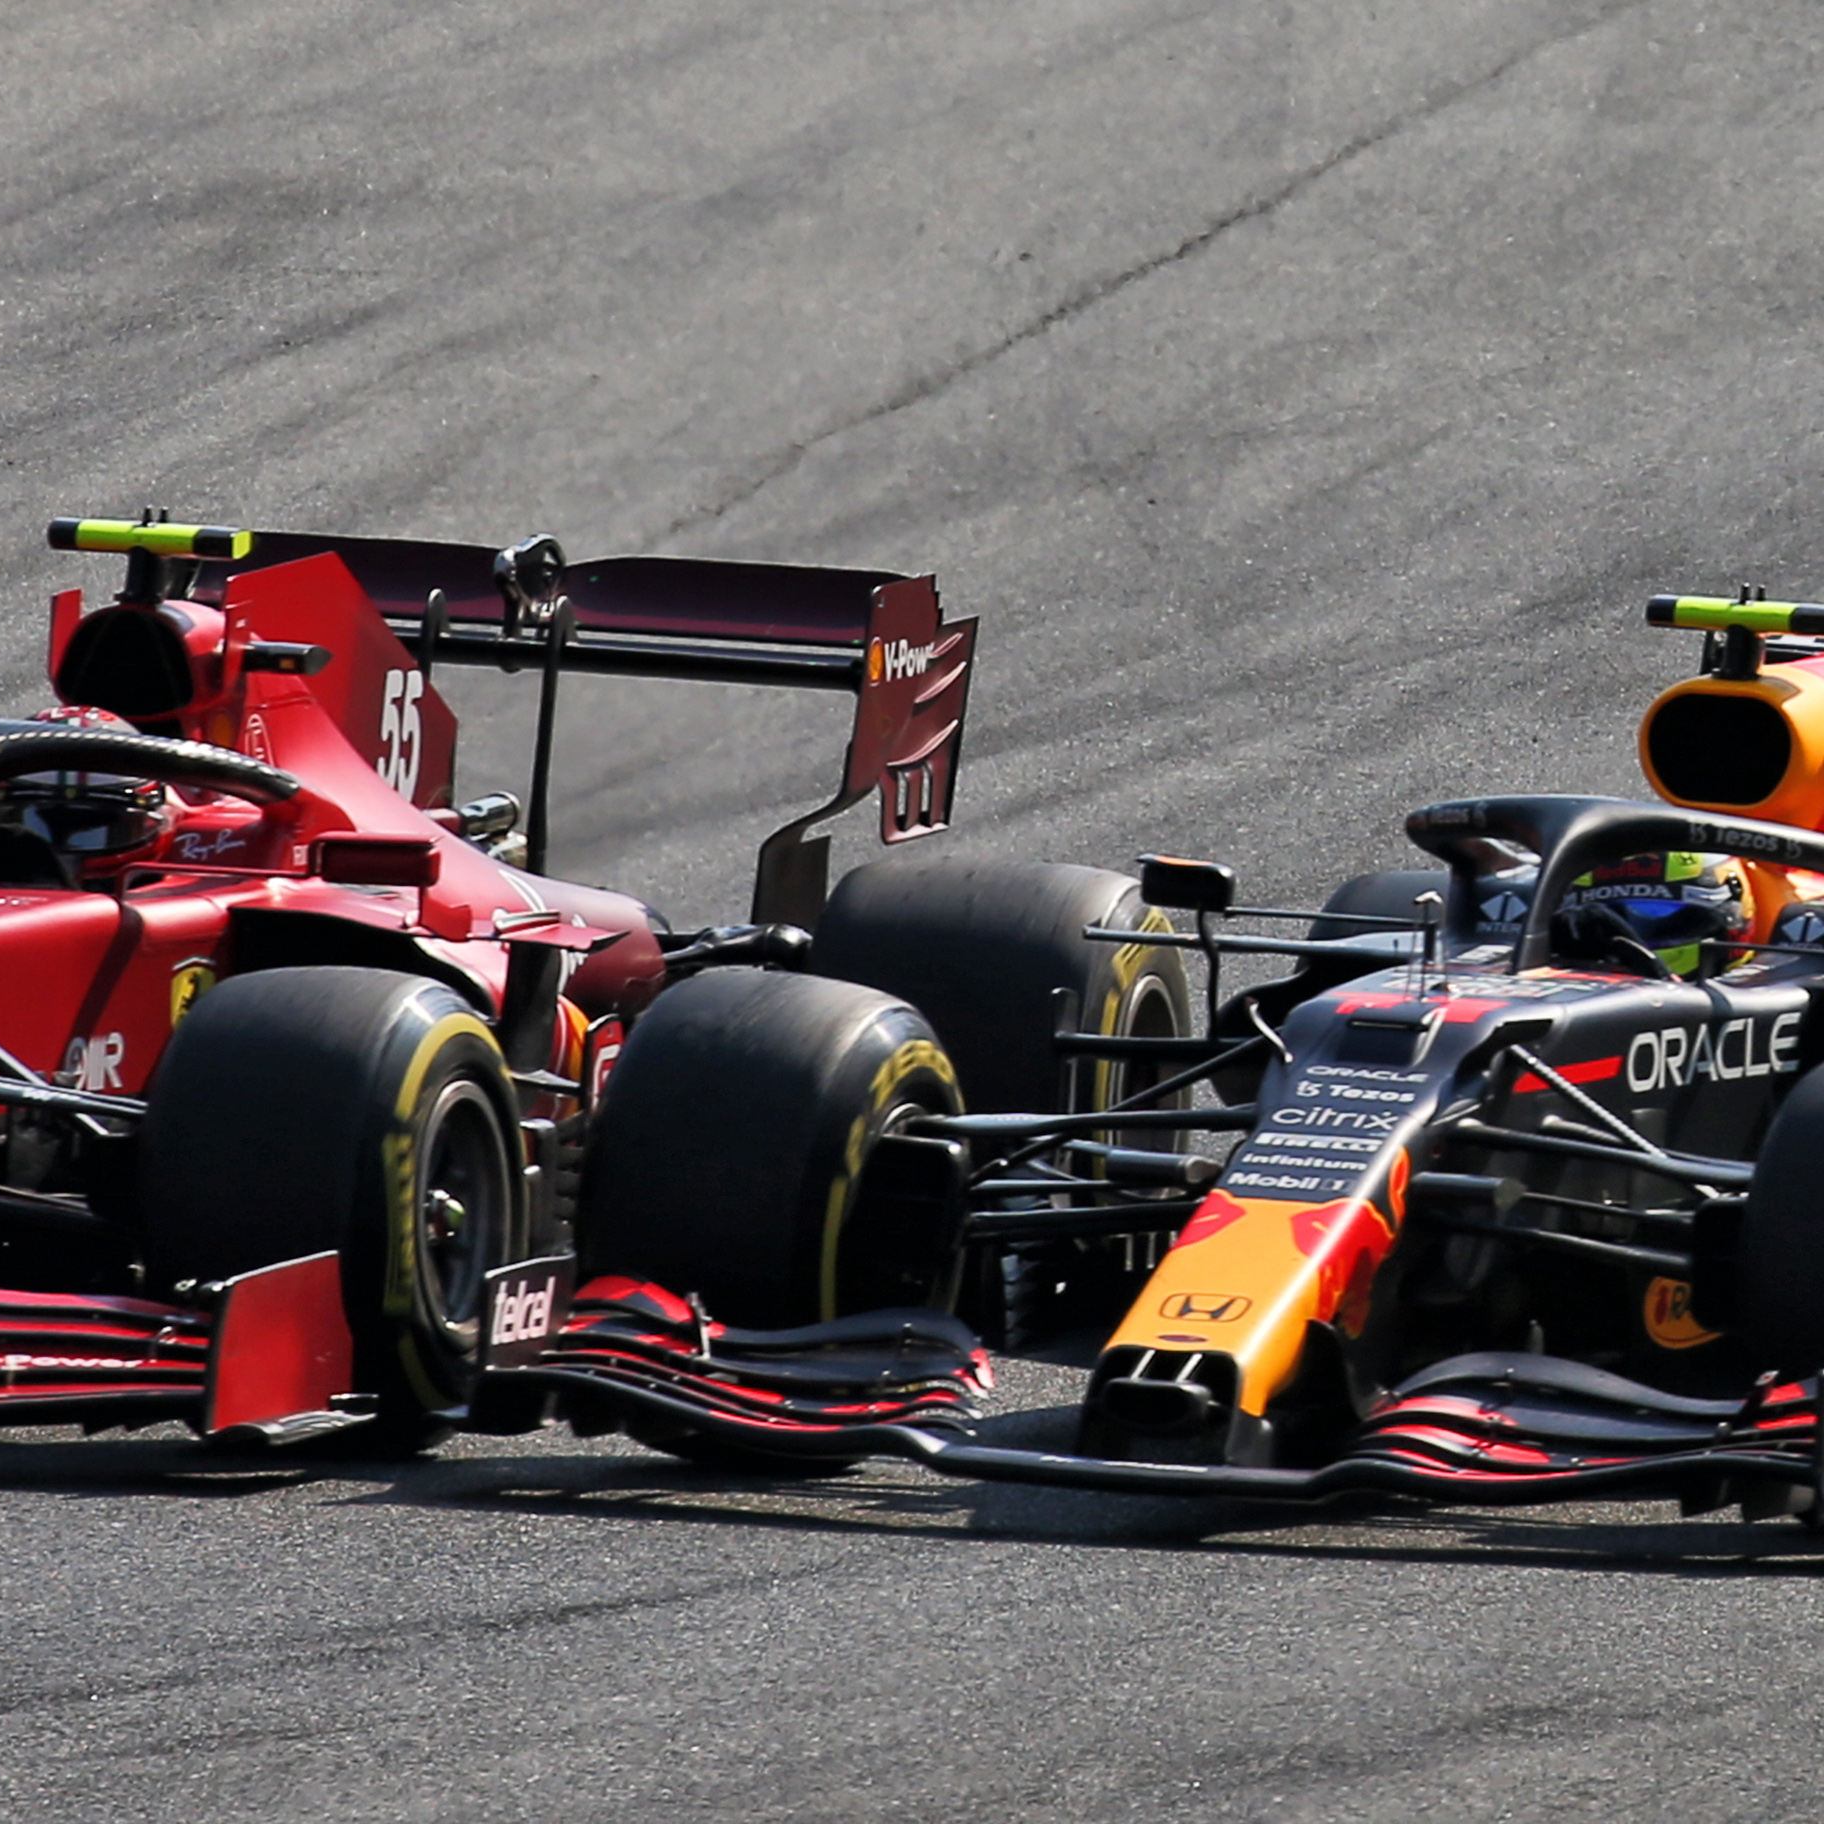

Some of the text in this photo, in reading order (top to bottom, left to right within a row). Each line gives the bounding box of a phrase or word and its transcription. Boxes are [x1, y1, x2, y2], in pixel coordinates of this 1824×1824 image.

[377, 669, 424, 804] 55
[1581, 883, 1674, 903] HONDA
[1627, 1011, 1802, 1093] ORACLE
[1306, 1065, 1430, 1083] ORACLE
[1329, 1084, 1416, 1103] Tezos
[1254, 1132, 1384, 1154] PIRELLI
[1227, 1172, 1321, 1190] Mobil
[491, 1276, 556, 1346] telcel
